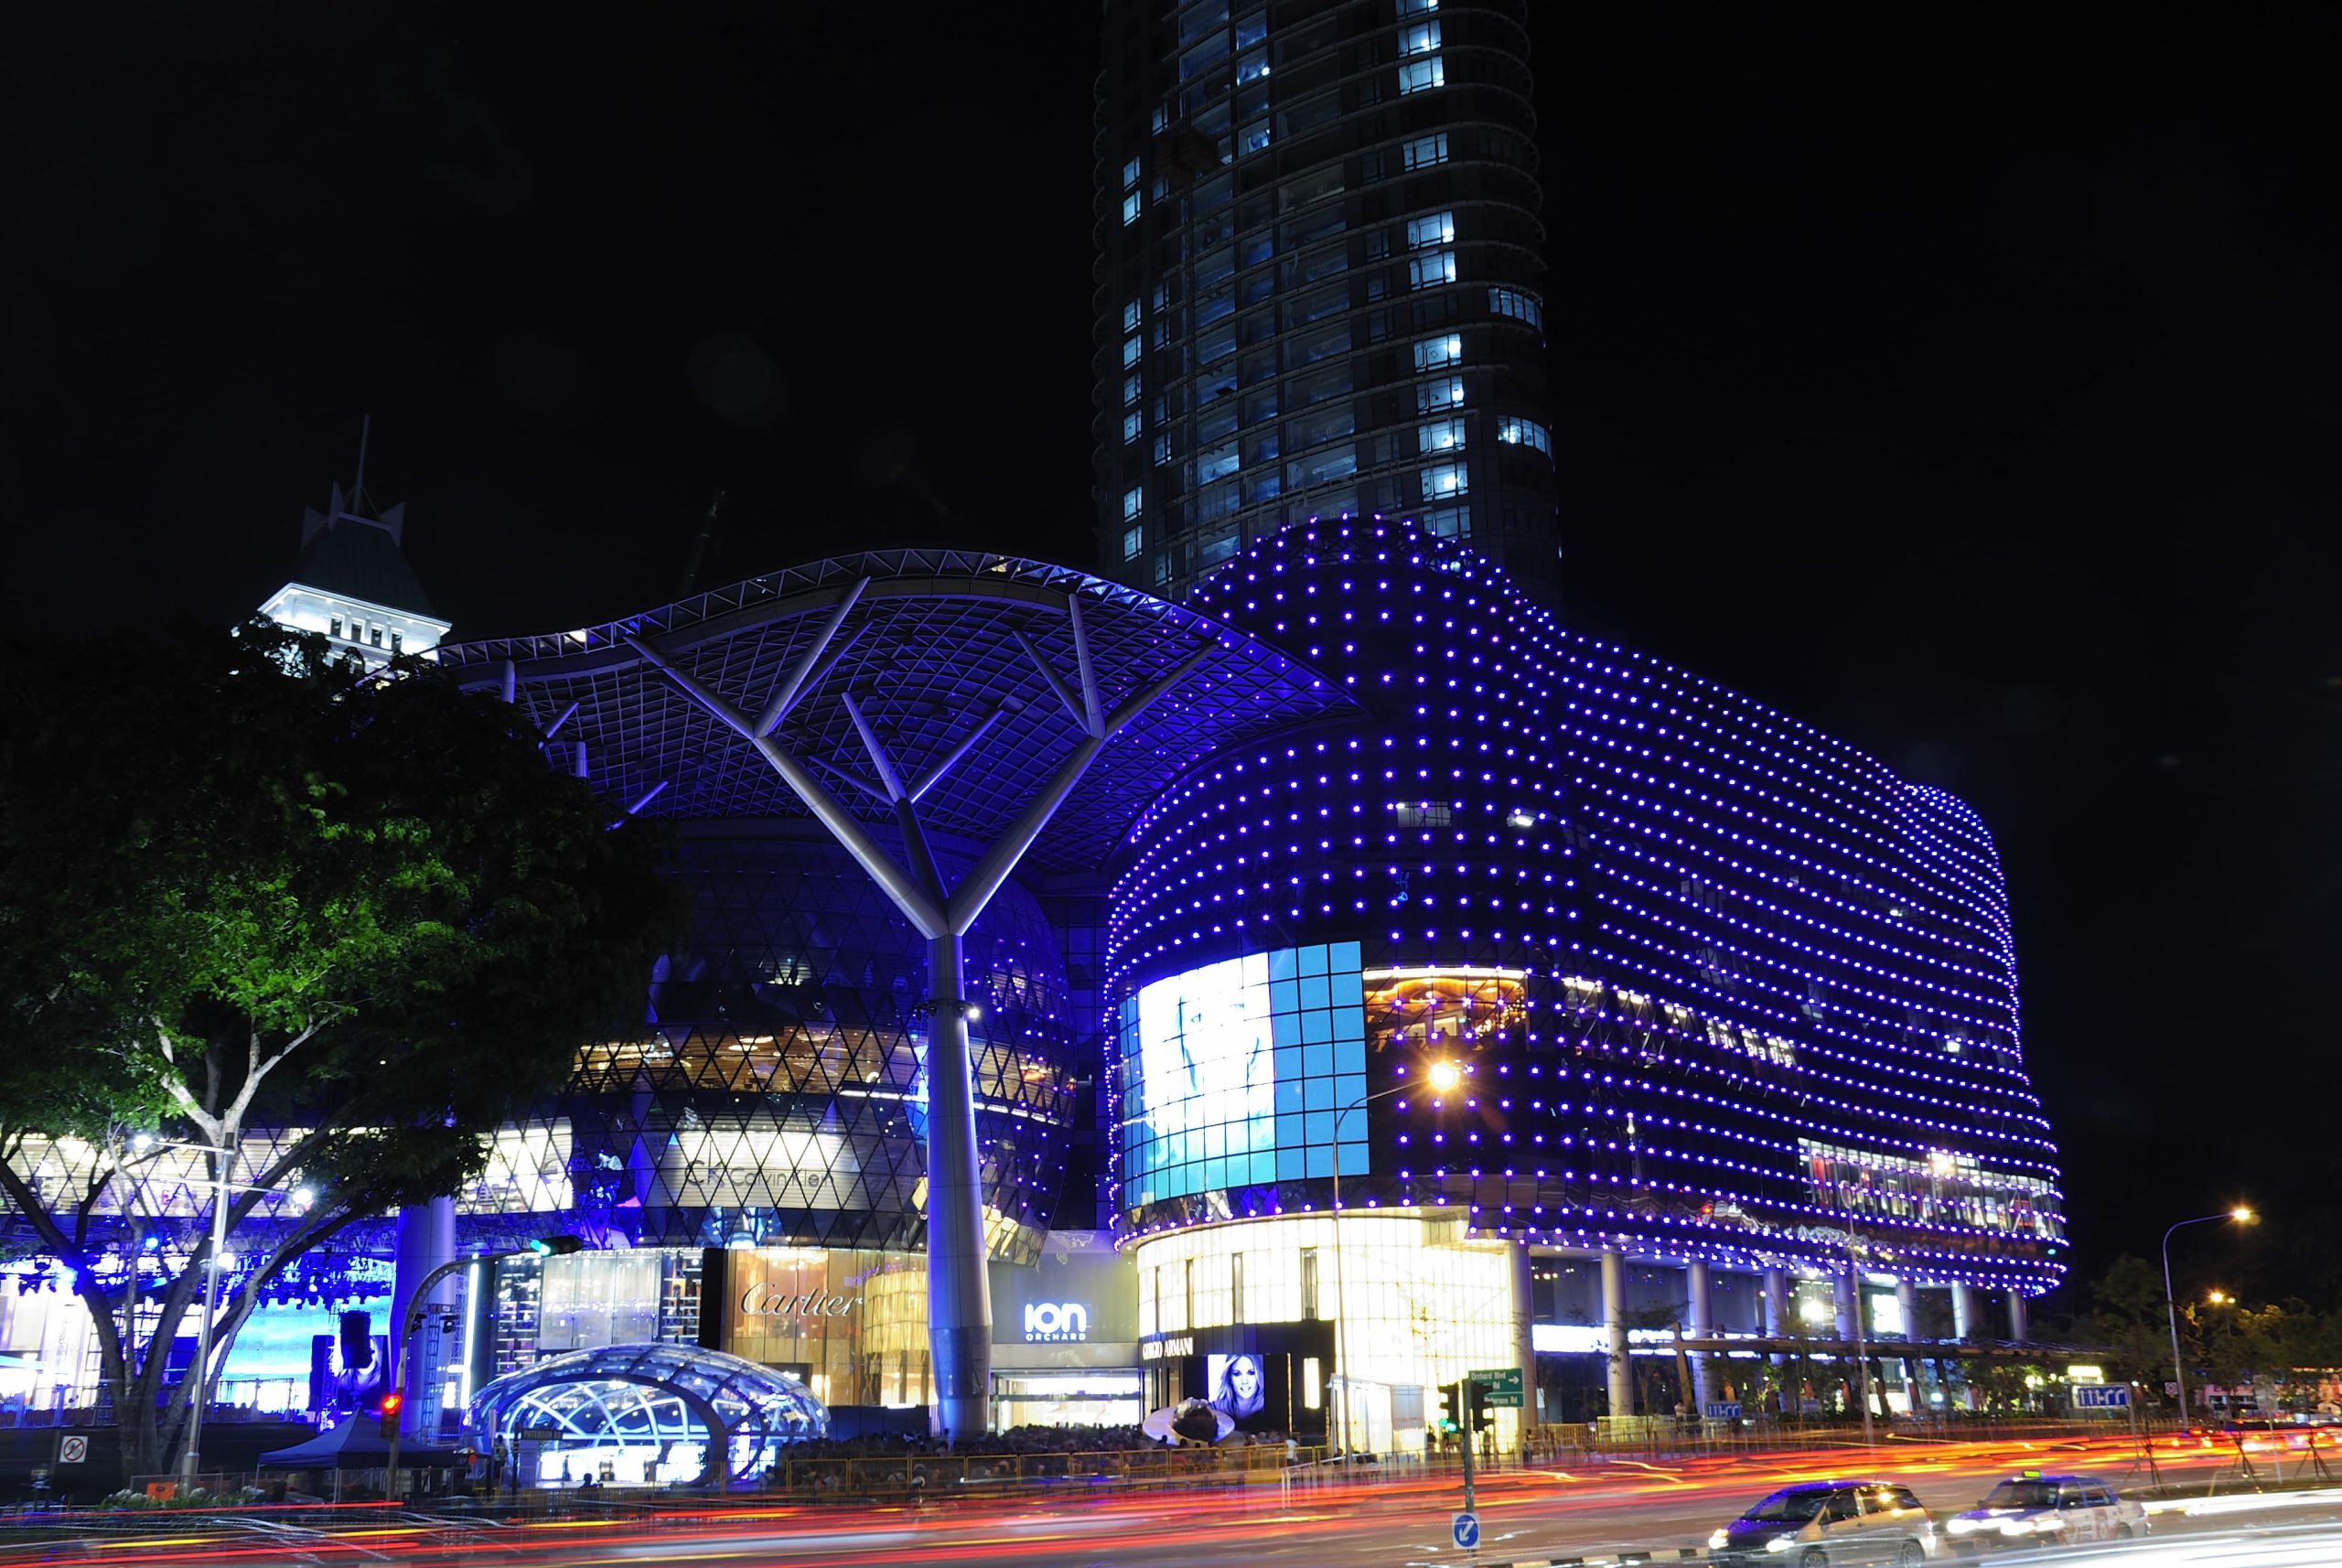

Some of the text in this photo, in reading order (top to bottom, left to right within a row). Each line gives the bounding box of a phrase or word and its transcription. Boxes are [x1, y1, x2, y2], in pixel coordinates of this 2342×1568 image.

[731, 1166, 787, 1187] Calvin
[792, 1167, 834, 1188] Klein
[740, 1282, 864, 1316] Cartier
[1026, 1333, 1086, 1341] ORCHARD
[1164, 1337, 1193, 1357] ARMANI
[1471, 1371, 1506, 1380] Orchard Blvd
[1509, 1396, 1518, 1404] Rd
